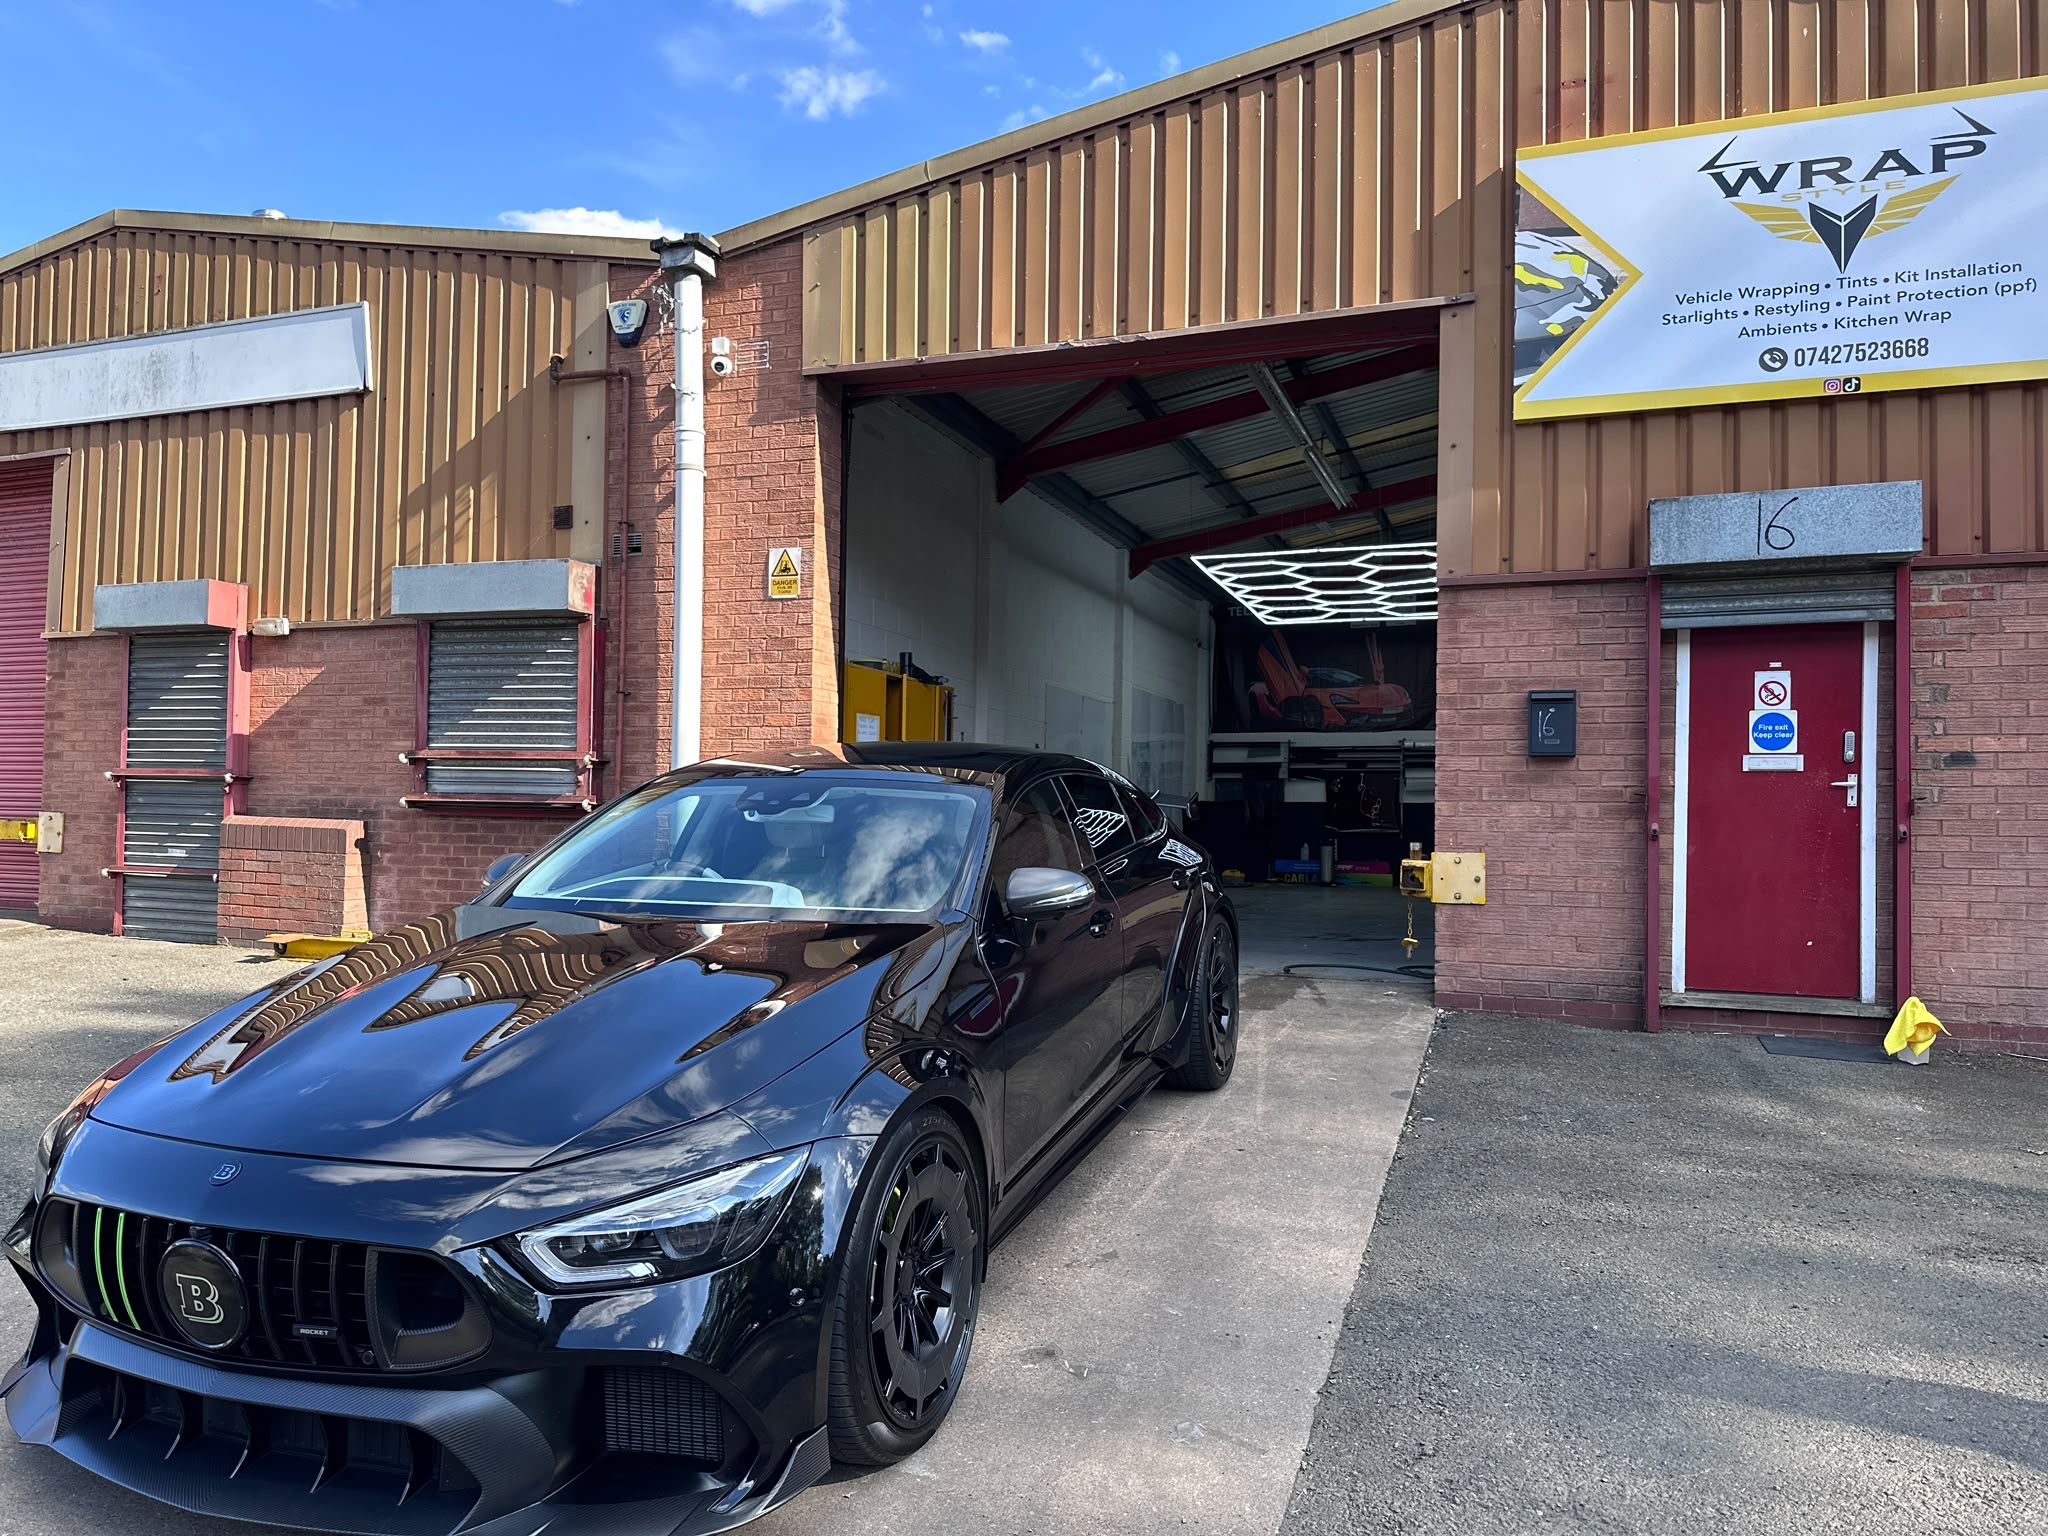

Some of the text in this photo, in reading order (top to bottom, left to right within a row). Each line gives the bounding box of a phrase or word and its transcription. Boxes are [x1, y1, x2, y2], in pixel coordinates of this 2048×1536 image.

[1706, 139, 1987, 199] WRAP
[1781, 180, 1906, 202] STYLE
[1675, 262, 2022, 306] Vehicle Wrapping Tints Kit Installation
[1662, 277, 2037, 326] Starlights Restyling Paint Protection (ppf)
[1738, 310, 1952, 339] Ambients Kitchen Wrap
[1793, 337, 1930, 368] 07427523668
[1756, 496, 1799, 556] 16
[1538, 708, 1556, 742] 16
[1753, 731, 1773, 739] Keep
[1758, 723, 1789, 731] Fire exit
[175, 1273, 225, 1324] B
[299, 1328, 329, 1336] ROCKET
